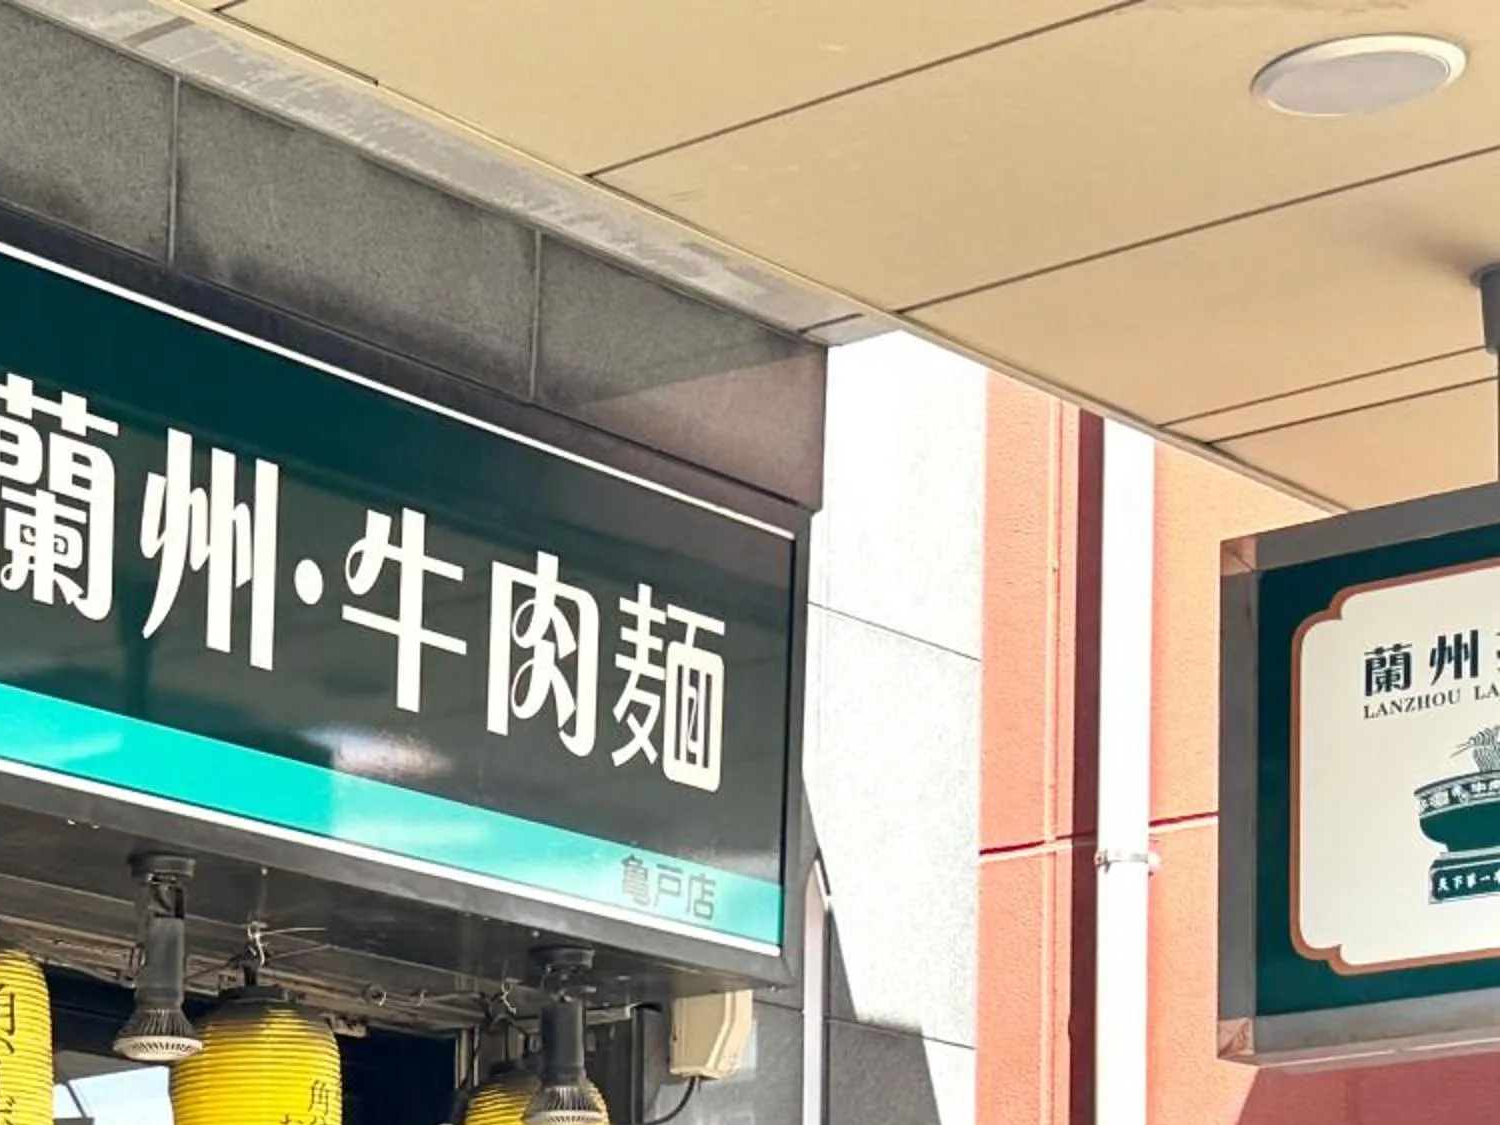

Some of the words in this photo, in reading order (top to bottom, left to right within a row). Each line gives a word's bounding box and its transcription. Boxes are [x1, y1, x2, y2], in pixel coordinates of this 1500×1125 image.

[1363, 628, 1500, 697] 蘭州
[1363, 687, 1461, 720] LANZHOU
[619, 853, 717, 922] 亀戸店
